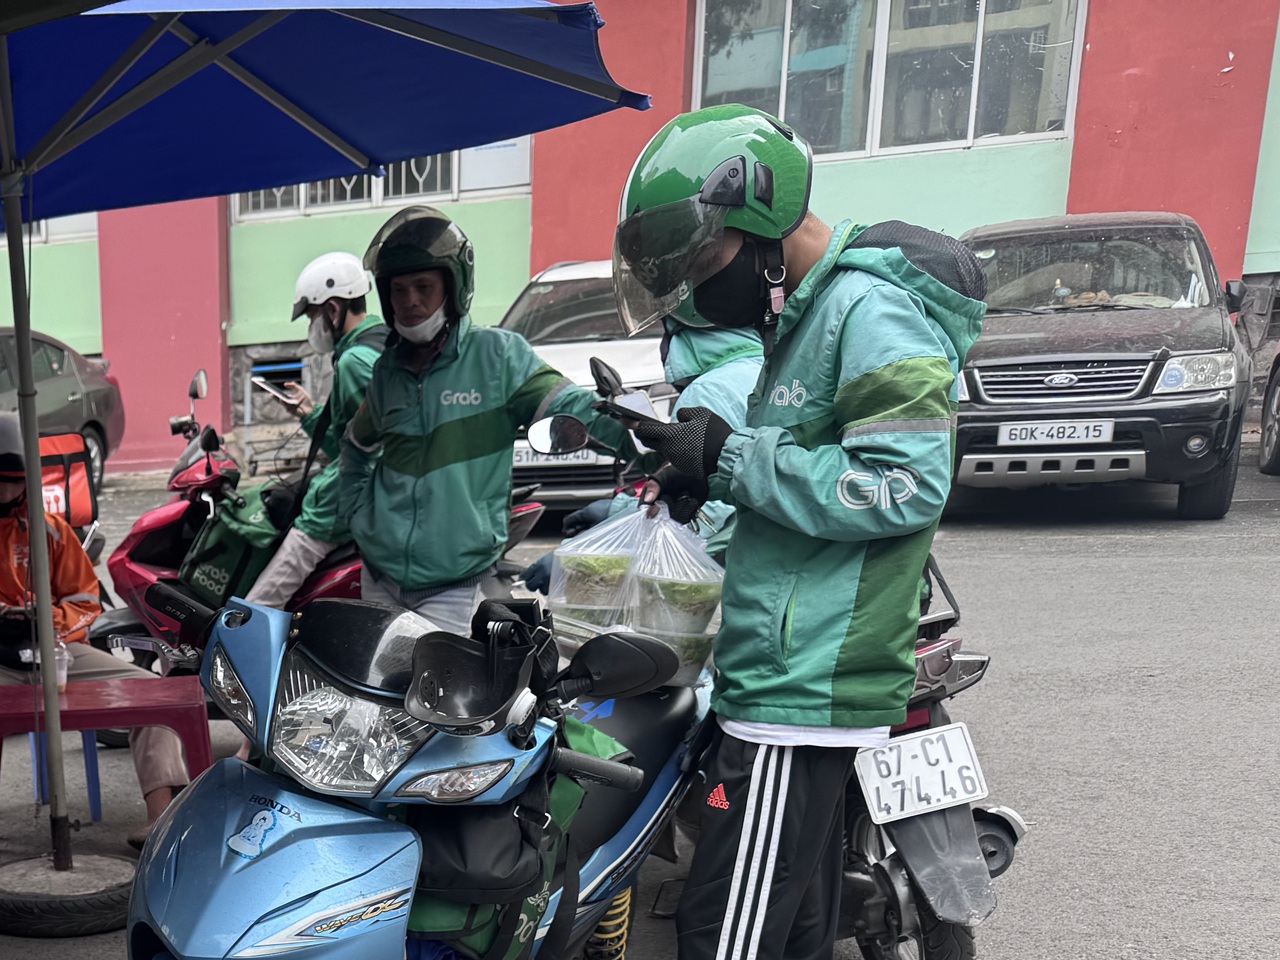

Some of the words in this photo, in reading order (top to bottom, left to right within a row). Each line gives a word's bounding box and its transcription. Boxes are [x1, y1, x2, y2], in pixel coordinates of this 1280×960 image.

[440, 388, 483, 406] Grab
[1008, 424, 1104, 441] 60K-482.15
[193, 567, 226, 596] Food
[872, 733, 954, 779] 67-C1
[875, 765, 978, 815] 474.46
[248, 794, 304, 824] HONDA
